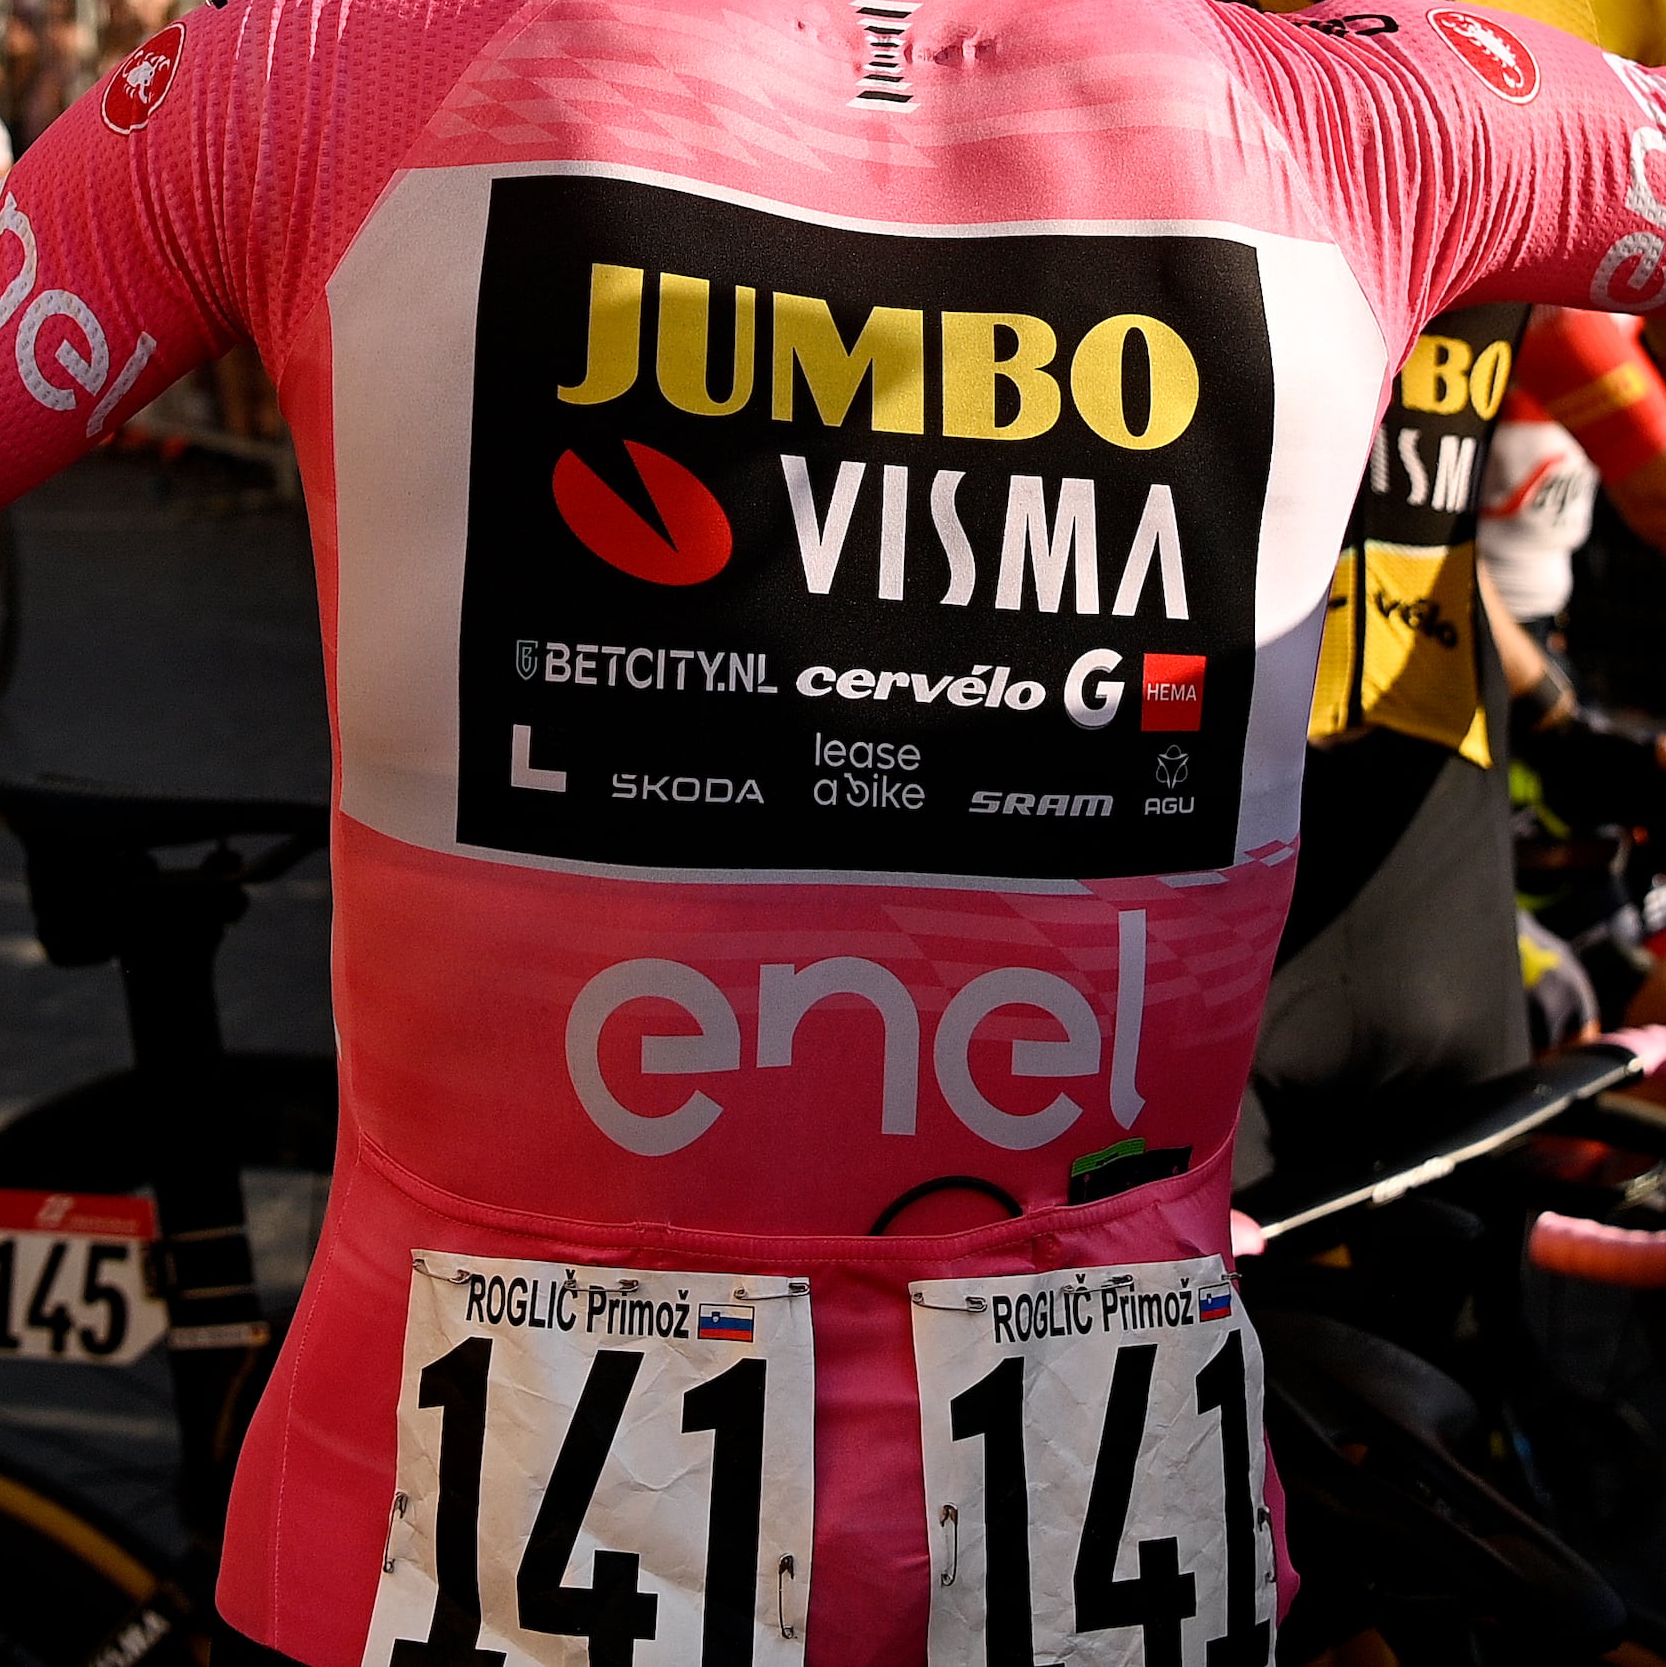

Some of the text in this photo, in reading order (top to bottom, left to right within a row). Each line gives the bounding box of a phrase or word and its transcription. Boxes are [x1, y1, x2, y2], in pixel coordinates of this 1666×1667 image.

[556, 263, 1200, 451] JUMBO
[1369, 423, 1477, 515] ISM
[779, 454, 1190, 620] VISMA
[545, 642, 1198, 730] BETCITY.NL cervélo G HEMA
[814, 732, 922, 771] lease
[968, 790, 1114, 818] SRAM
[1144, 796, 1196, 816] AGU
[565, 909, 1147, 1158] enel
[466, 1269, 691, 1339] ROGLIČ Primož
[991, 1273, 1195, 1344] ROGLIČ Primož
[390, 1336, 768, 1667] 141
[949, 1328, 1271, 1667] 141
